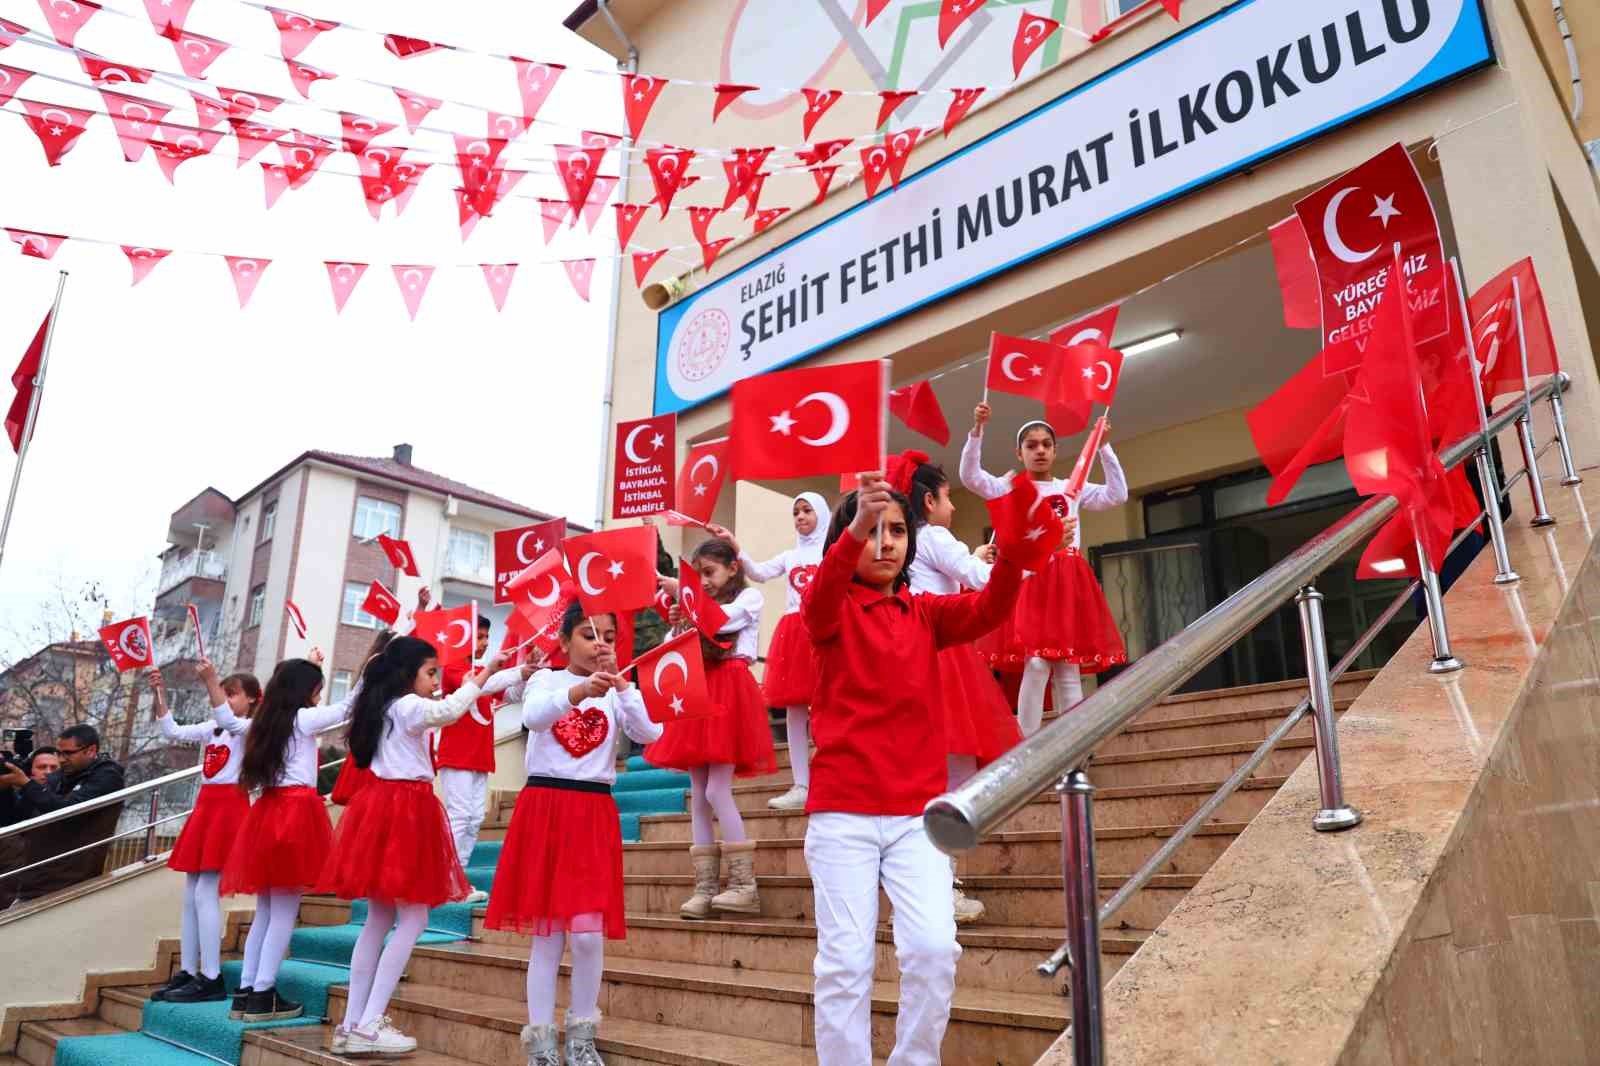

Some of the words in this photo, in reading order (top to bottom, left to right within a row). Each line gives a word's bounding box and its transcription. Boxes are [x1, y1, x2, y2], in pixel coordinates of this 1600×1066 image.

[740, 272, 830, 361] ŞEHİT
[840, 208, 943, 305] FETHİ
[956, 131, 1114, 250] MURAT
[1128, 0, 1431, 169] İLKOKULU
[740, 262, 785, 304] ELAZIĞ
[1332, 253, 1428, 307] YÜREĞİZ
[625, 464, 664, 477] İSTİKLAL
[620, 502, 665, 515] MAARİFLE
[624, 489, 663, 502] İSTİKBAL
